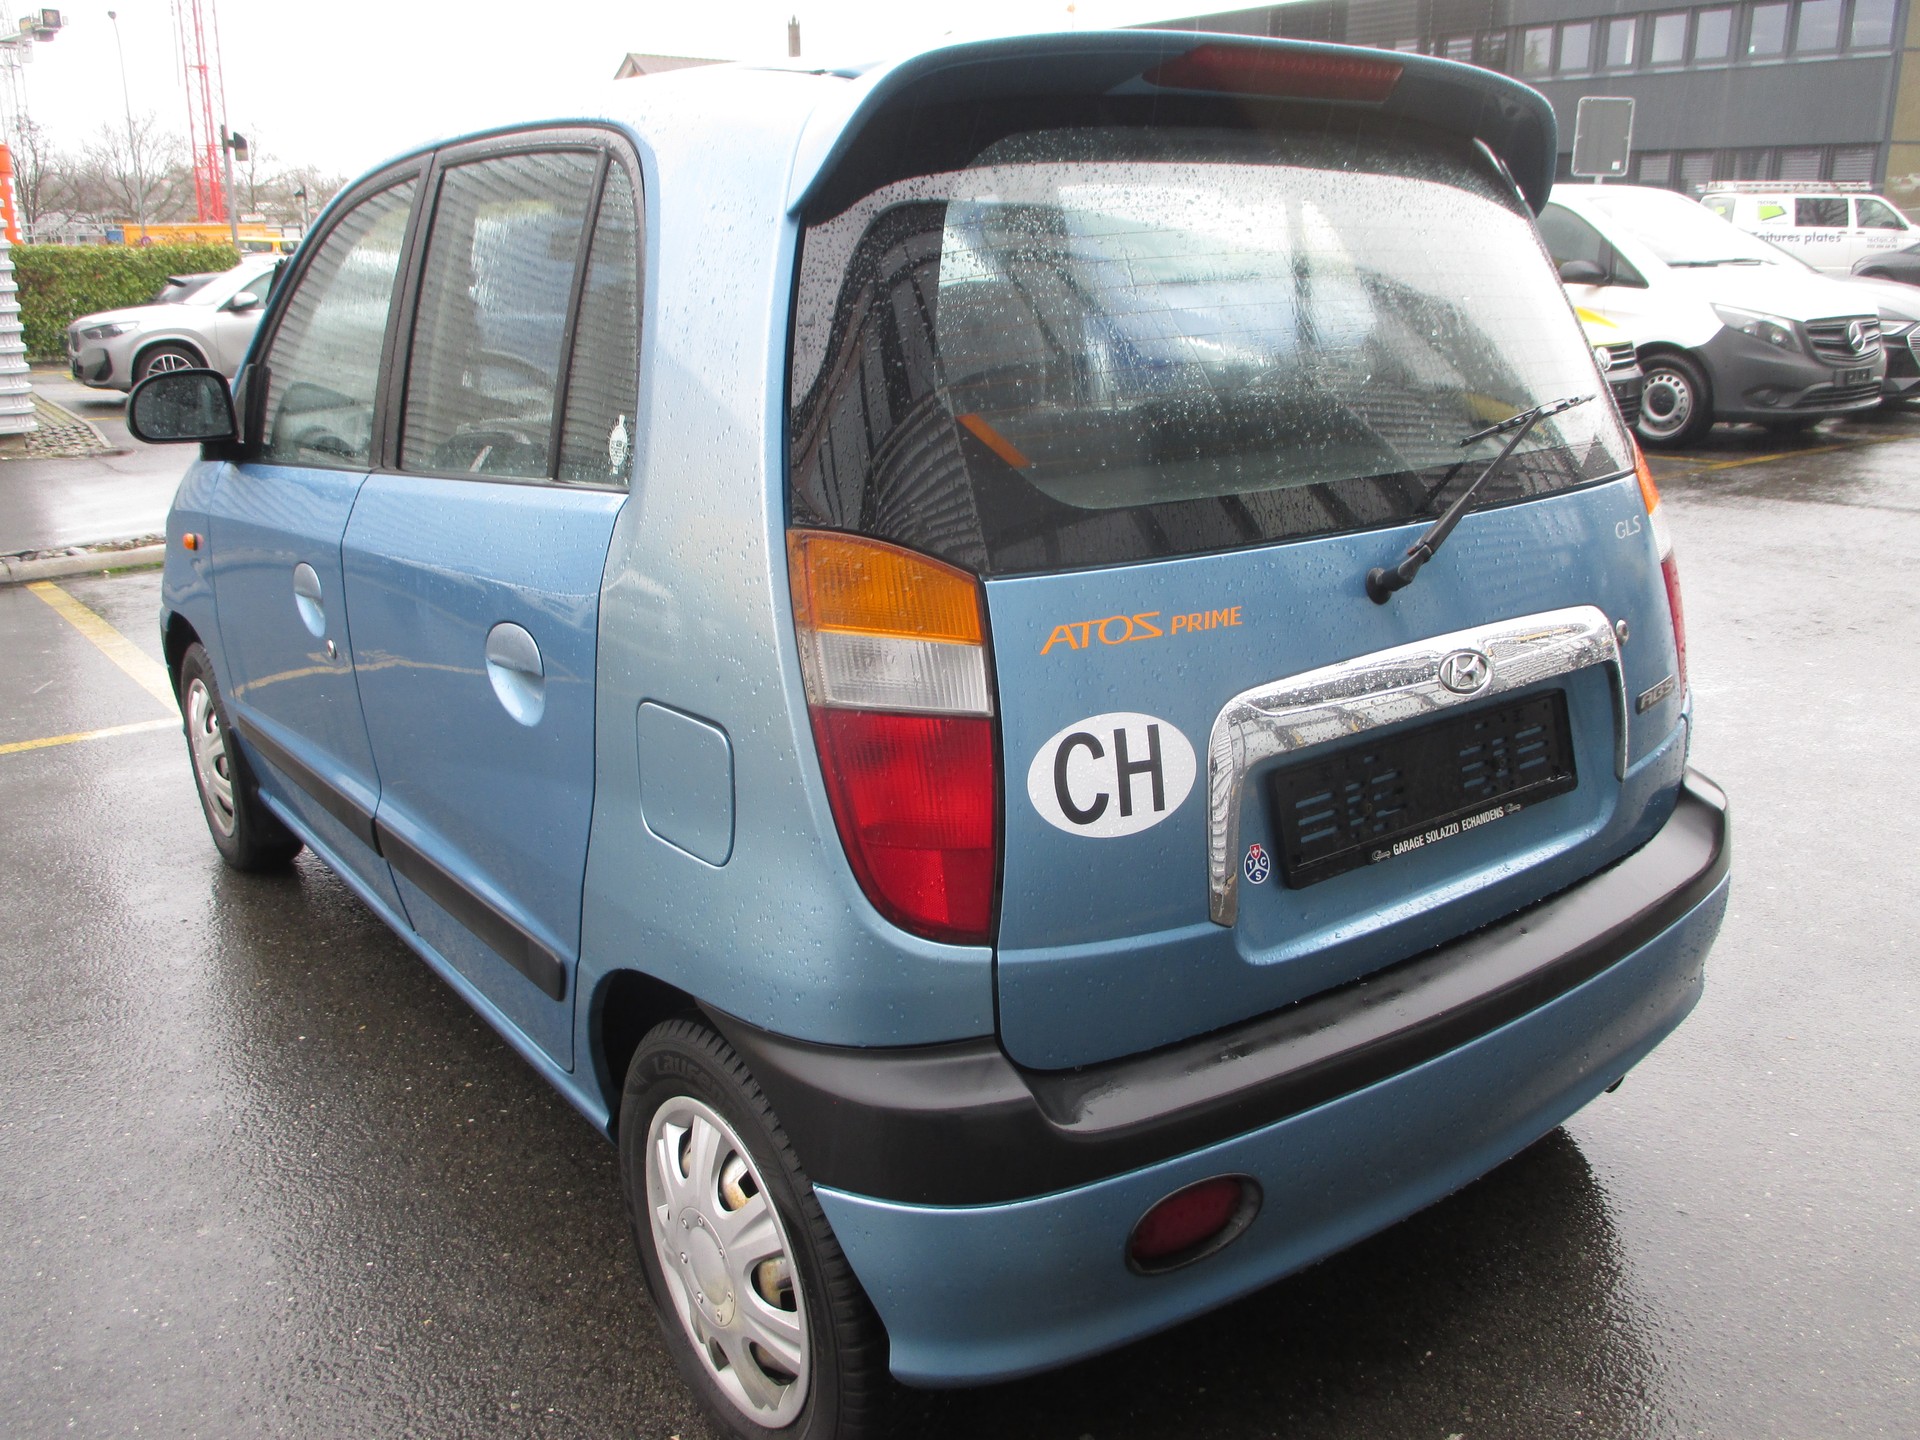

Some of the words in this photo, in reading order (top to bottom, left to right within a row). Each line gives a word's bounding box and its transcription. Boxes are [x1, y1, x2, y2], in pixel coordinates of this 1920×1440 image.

[1804, 231, 1841, 245] plates
[1615, 514, 1641, 539] GLS
[1040, 611, 1163, 655] ATOS
[1171, 606, 1243, 635] PRIME
[1053, 723, 1165, 825] CH
[1393, 834, 1425, 856] GARAGE
[1425, 822, 1460, 844] SOLAZZO
[1461, 806, 1504, 831] ECHANDENS
